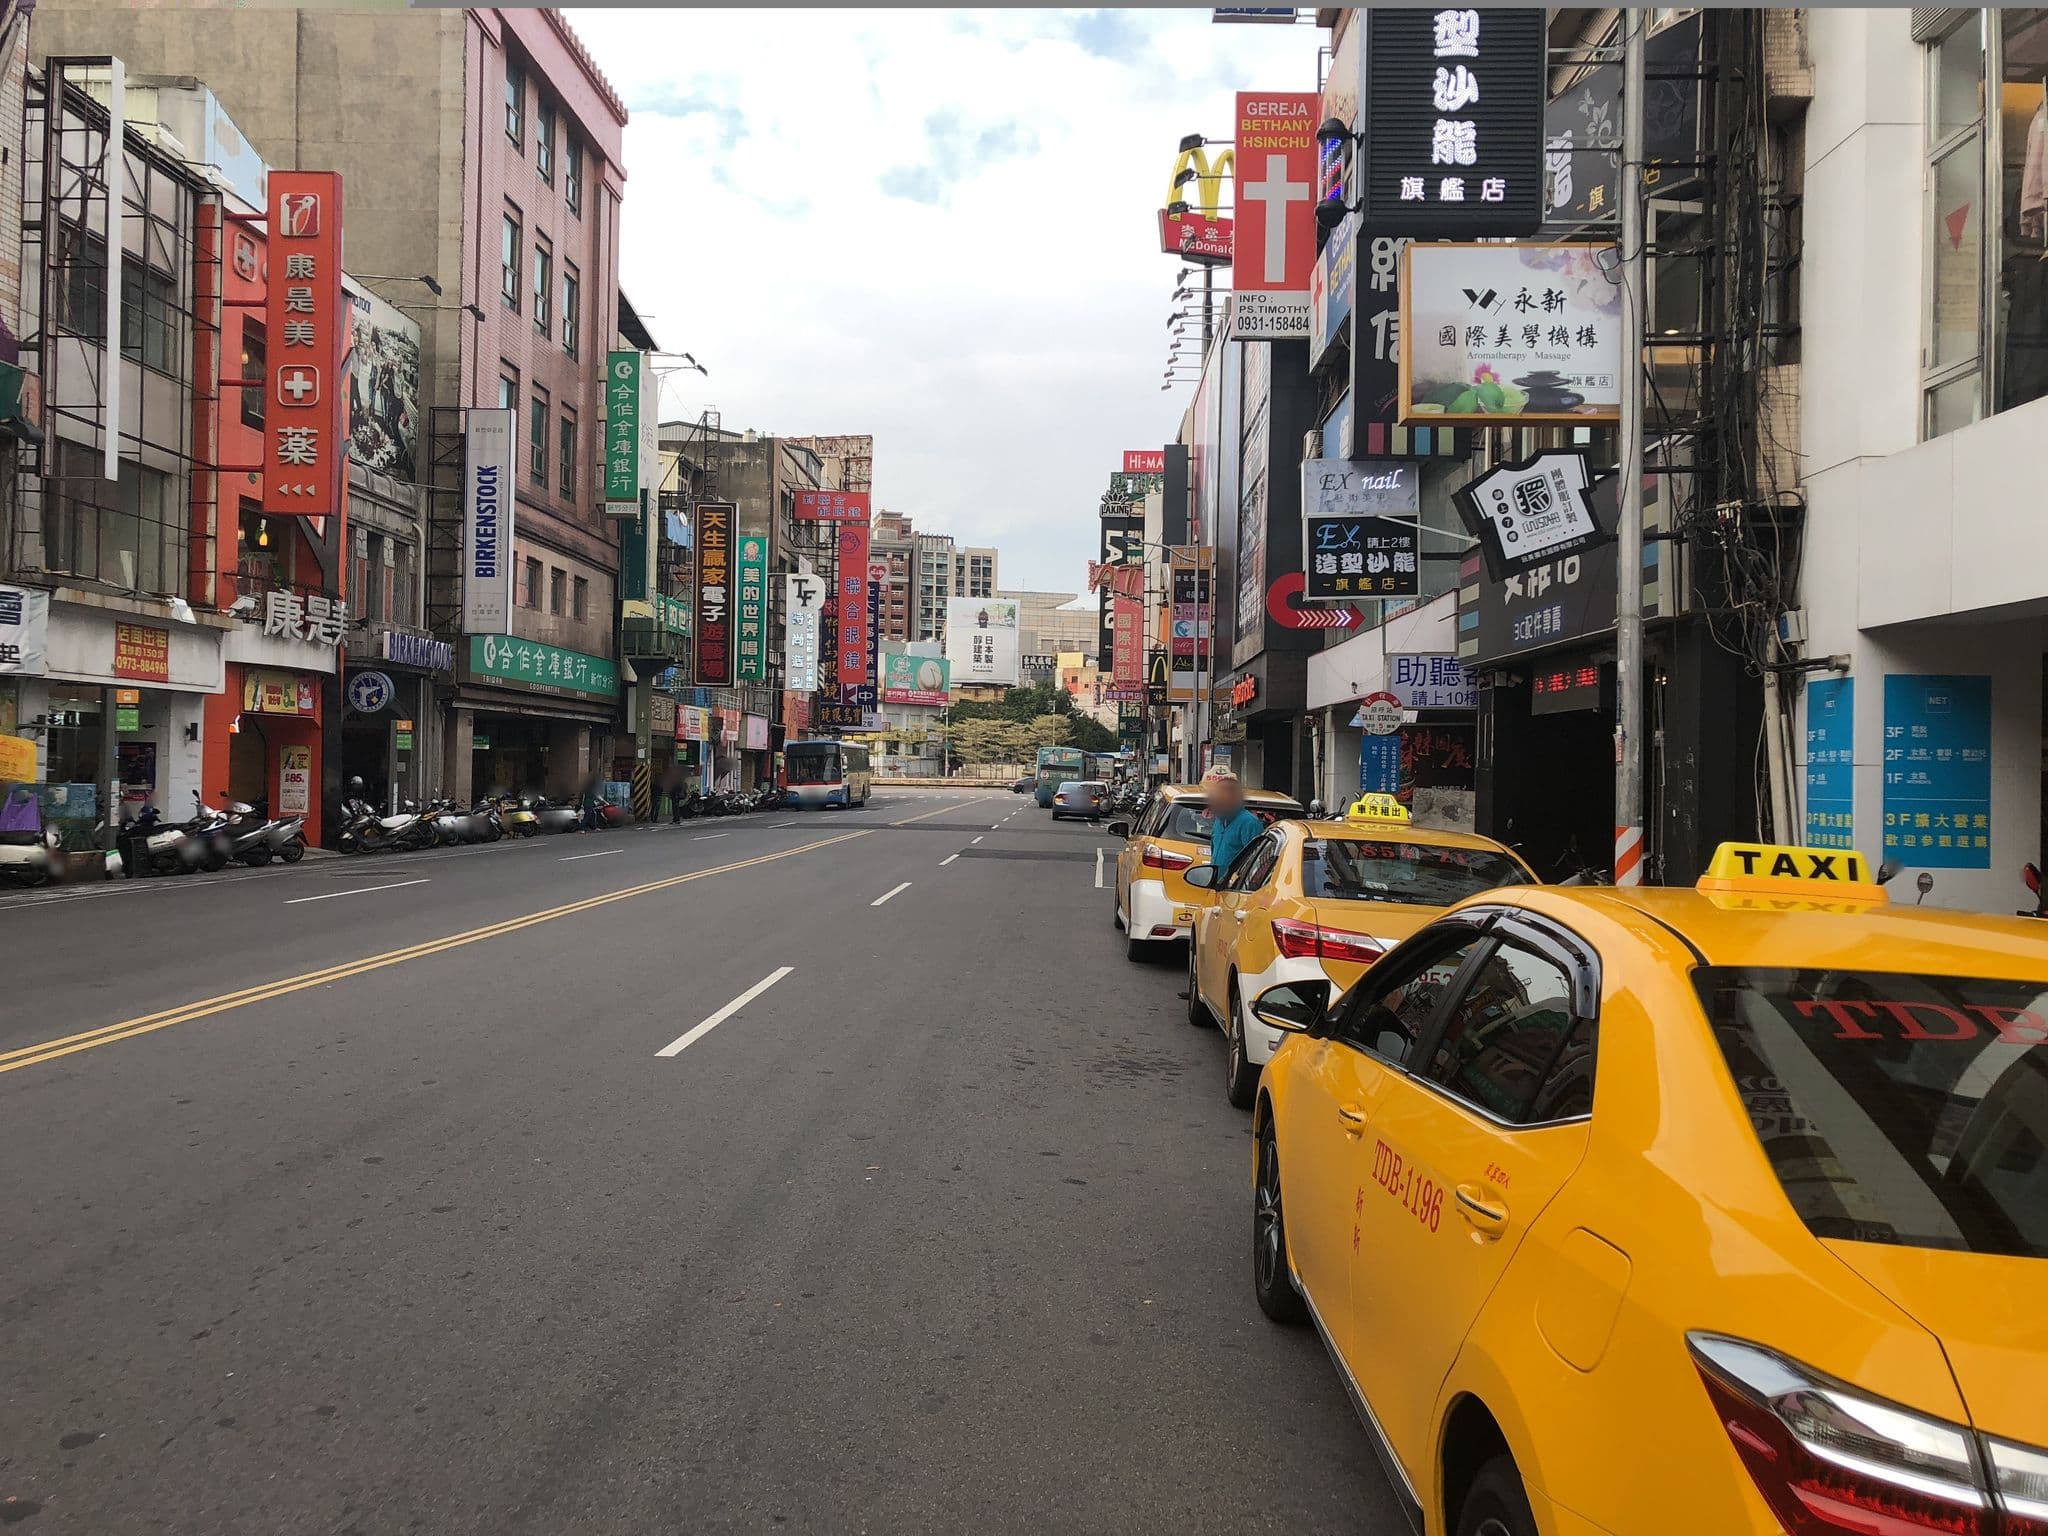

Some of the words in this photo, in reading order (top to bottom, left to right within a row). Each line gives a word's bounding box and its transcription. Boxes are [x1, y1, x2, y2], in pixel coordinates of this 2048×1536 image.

[1246, 101, 1308, 116] GEREJA
[1241, 119, 1313, 131] BETHANY
[1243, 136, 1310, 149] HSINCHU
[1400, 177, 1506, 202] 旗艦店
[284, 253, 315, 348] 康是美
[1239, 294, 1267, 303] INFO
[1514, 287, 1567, 314] 永新
[1239, 305, 1310, 314] PS.TIMOTHY
[1238, 316, 1310, 331] 0931-158484
[1438, 323, 1599, 349] 國際美學機構
[1466, 351, 1527, 361] Aromatherapy
[1535, 351, 1572, 361] Massage
[1571, 374, 1610, 387] 旗艦店
[611, 383, 635, 492] 合作金庫銀行
[1319, 472, 1353, 491] EX
[1362, 469, 1404, 490] nail
[475, 465, 498, 578] BIRKENSTOCK
[1367, 537, 1411, 548] 請上2樓
[1315, 552, 1416, 575] 造型沙龍
[740, 568, 760, 674] 美的世界唱片
[117, 625, 167, 648] 店面出租
[498, 639, 588, 684] 合作金庫銀行
[1928, 696, 1948, 705] NET
[1886, 726, 1904, 738] 3F
[1886, 749, 1904, 761] 2F
[1886, 772, 1904, 784] 1F
[1734, 850, 1860, 884] TAXI
[1371, 1138, 1444, 1233] TDB-1196
